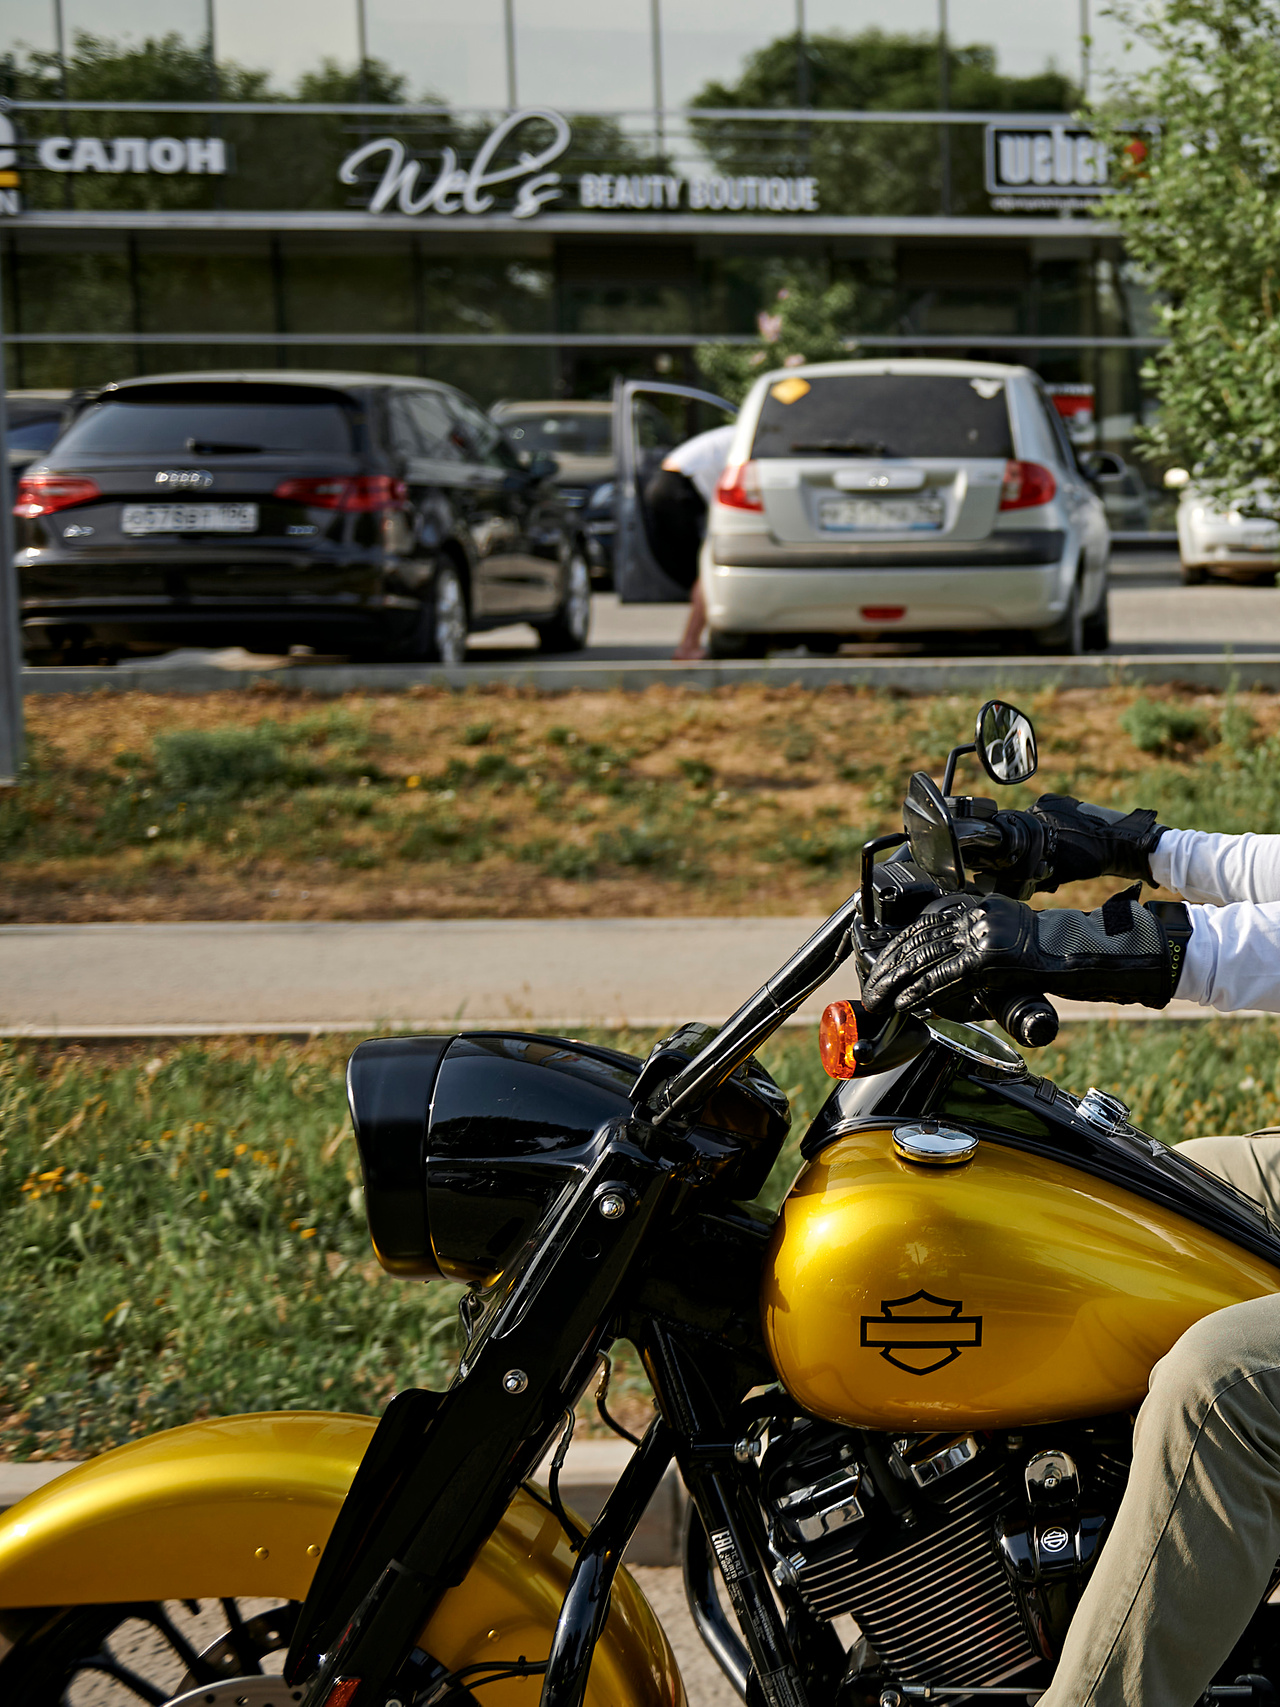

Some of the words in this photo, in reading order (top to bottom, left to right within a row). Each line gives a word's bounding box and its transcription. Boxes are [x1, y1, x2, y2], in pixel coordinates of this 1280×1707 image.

[37, 136, 227, 174] САЛОН
[579, 172, 682, 209] BEAUTY
[687, 174, 820, 211] BOUTIQUE
